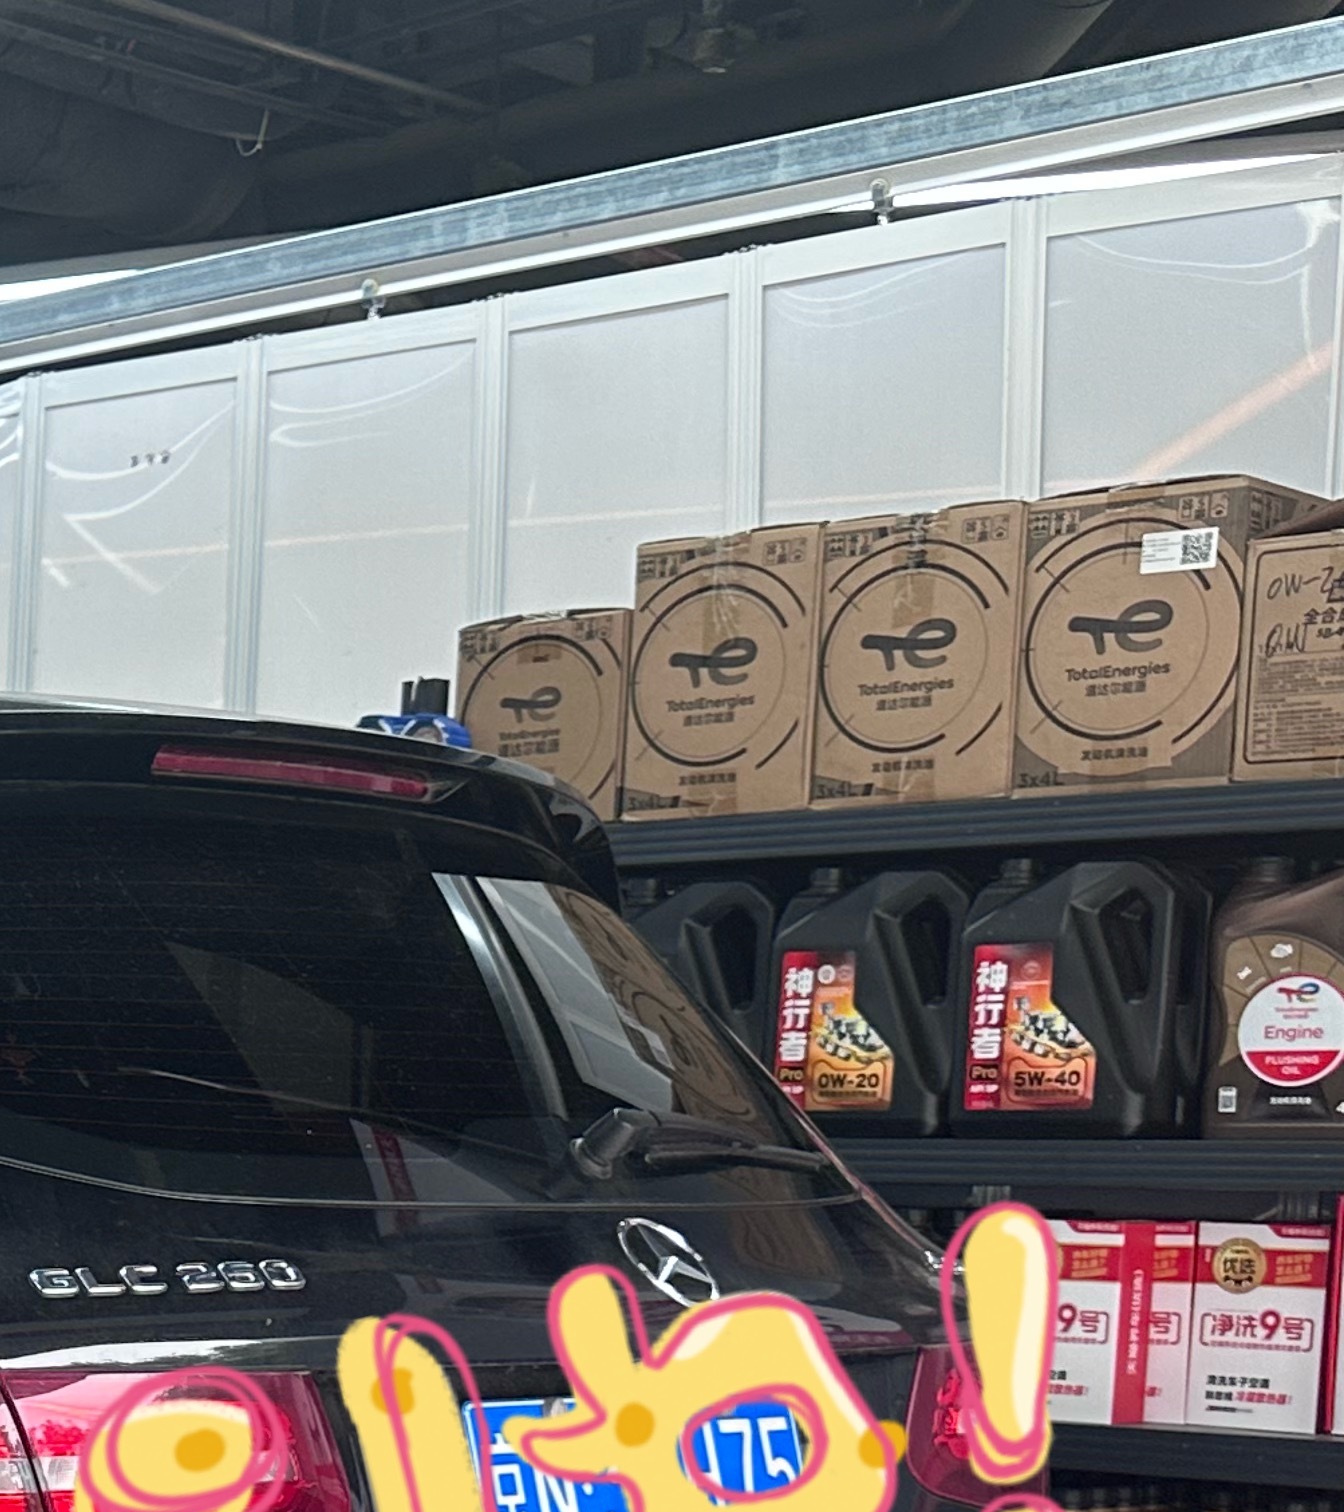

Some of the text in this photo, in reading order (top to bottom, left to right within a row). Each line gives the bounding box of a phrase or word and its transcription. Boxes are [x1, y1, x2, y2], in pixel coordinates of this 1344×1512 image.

[1065, 661, 1171, 683] TotalEnergies
[857, 678, 955, 697] TotalEnergies
[665, 694, 756, 713] TotalEnergies
[778, 967, 815, 1062] 神行者
[970, 961, 1009, 1060] 神行者
[1263, 1024, 1325, 1043] Engine
[779, 1068, 804, 1081] Pro
[817, 1072, 880, 1089] 0W-20
[971, 1065, 998, 1079] Pro
[1013, 1070, 1081, 1088] 5W-40
[29, 1258, 306, 1299] GLC 260
[1210, 1309, 1306, 1342] 净洗9号
